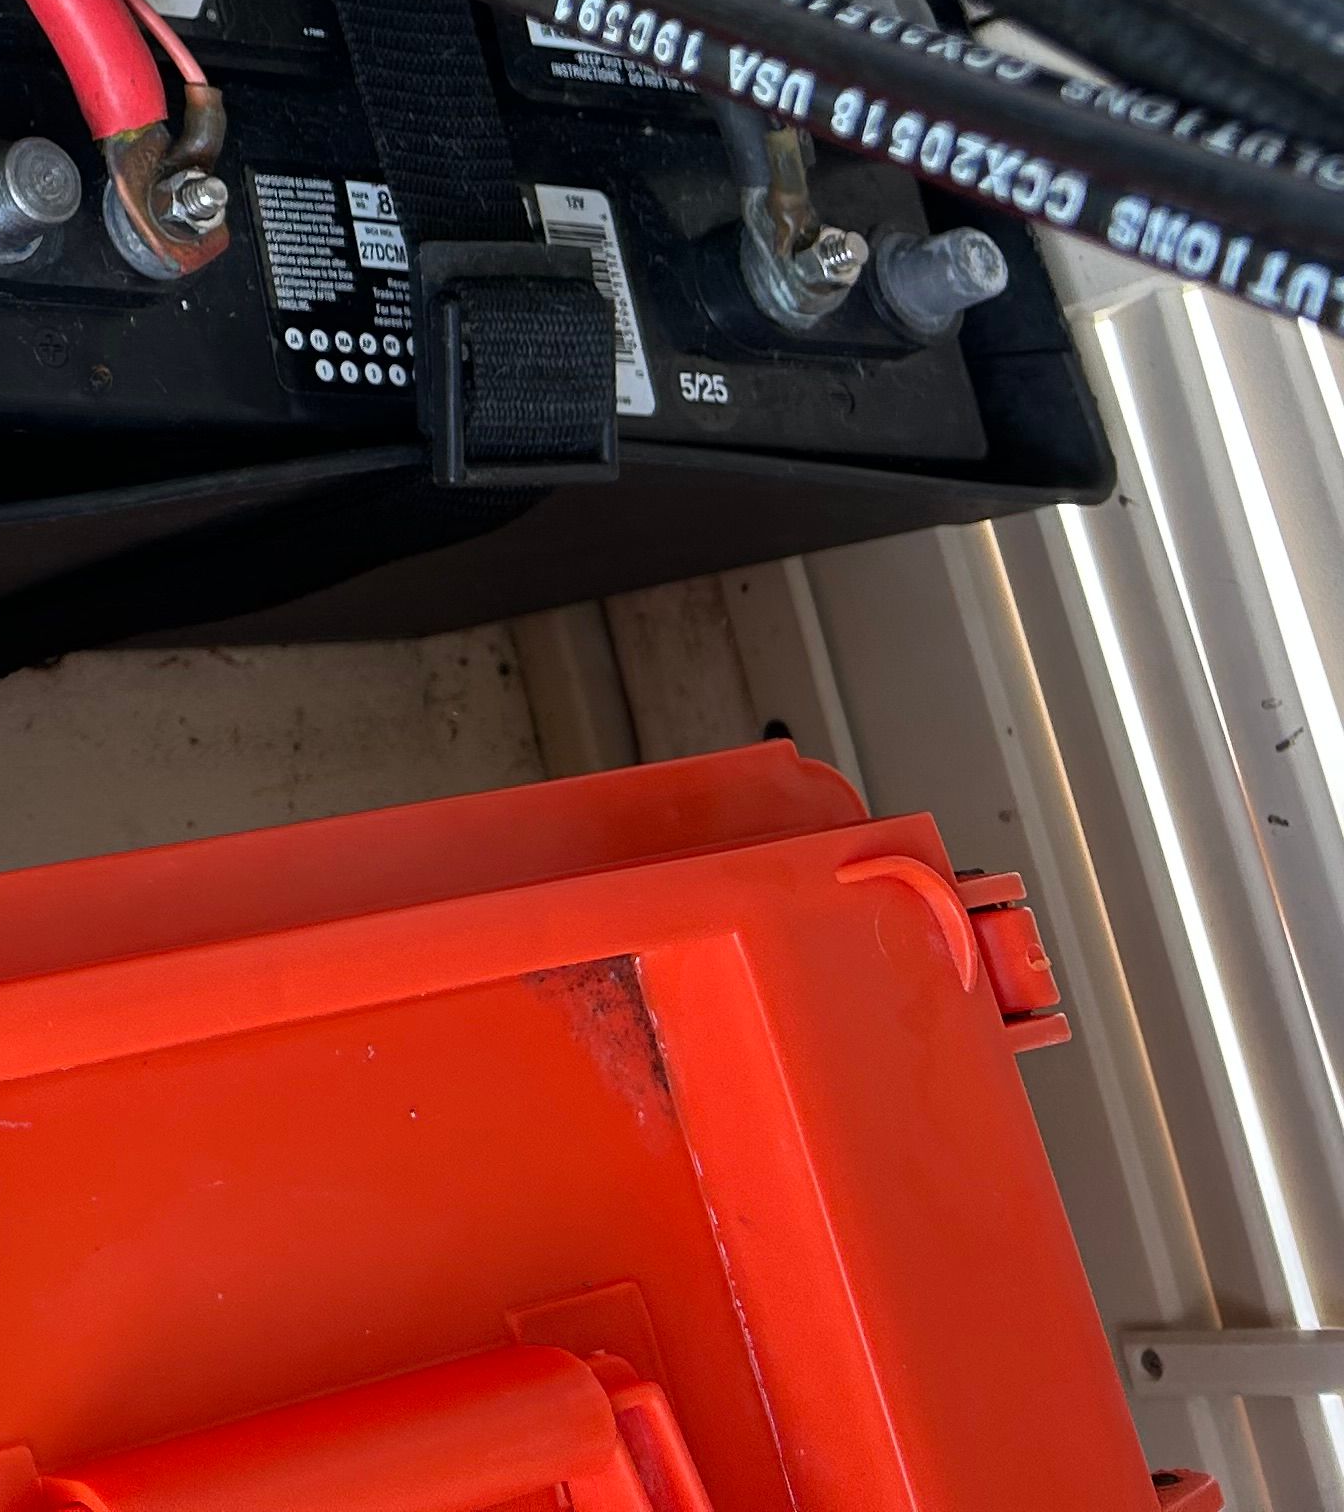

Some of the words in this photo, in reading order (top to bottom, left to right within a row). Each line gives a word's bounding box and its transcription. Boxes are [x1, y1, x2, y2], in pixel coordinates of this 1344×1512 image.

[729, 44, 817, 120] USA
[831, 88, 1089, 225] CCX20518
[360, 243, 407, 264] 27DCM
[679, 372, 729, 404] 5/25
